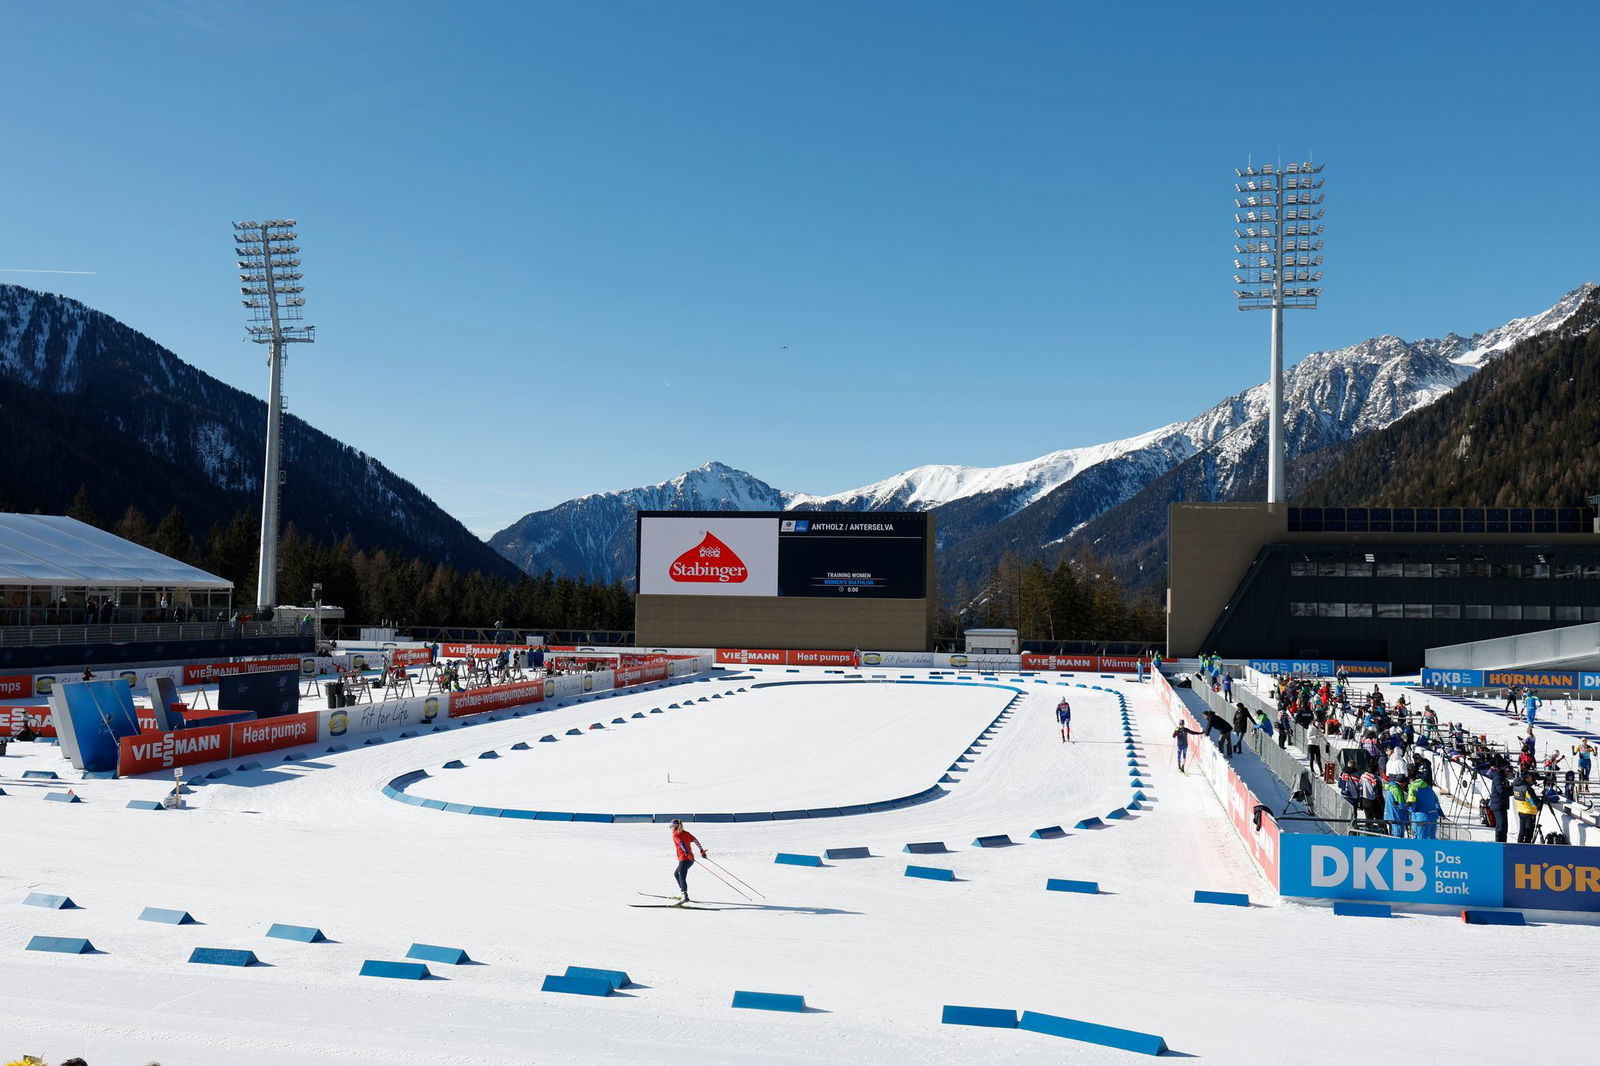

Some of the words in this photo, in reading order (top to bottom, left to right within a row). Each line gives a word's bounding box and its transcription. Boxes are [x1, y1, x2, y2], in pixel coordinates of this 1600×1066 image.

[811, 523, 844, 531] ANTHOLZ
[849, 523, 894, 531] ANTERSELVA
[672, 562, 745, 582] Stabinger
[397, 649, 430, 665] VIESSMANN
[722, 649, 779, 663] VIESSMANN
[797, 653, 817, 661] Heat
[820, 654, 850, 663] pumps
[1028, 655, 1091, 670] VIESSMANN
[1252, 662, 1279, 673] DKB
[1292, 662, 1320, 673] DKB
[1431, 672, 1461, 683] DKB
[1489, 672, 1573, 686] HÖRMANN
[360, 705, 375, 727] Fit
[377, 704, 391, 731] for
[392, 701, 408, 726] Life
[242, 726, 270, 744] Heat
[271, 722, 307, 744] pumps
[131, 733, 221, 767] VIESSMANN
[1435, 851, 1461, 864] Das
[1310, 844, 1427, 892] DKB
[1435, 866, 1468, 880] kann
[1514, 862, 1600, 893] HÖR
[1435, 881, 1470, 895] Bank
